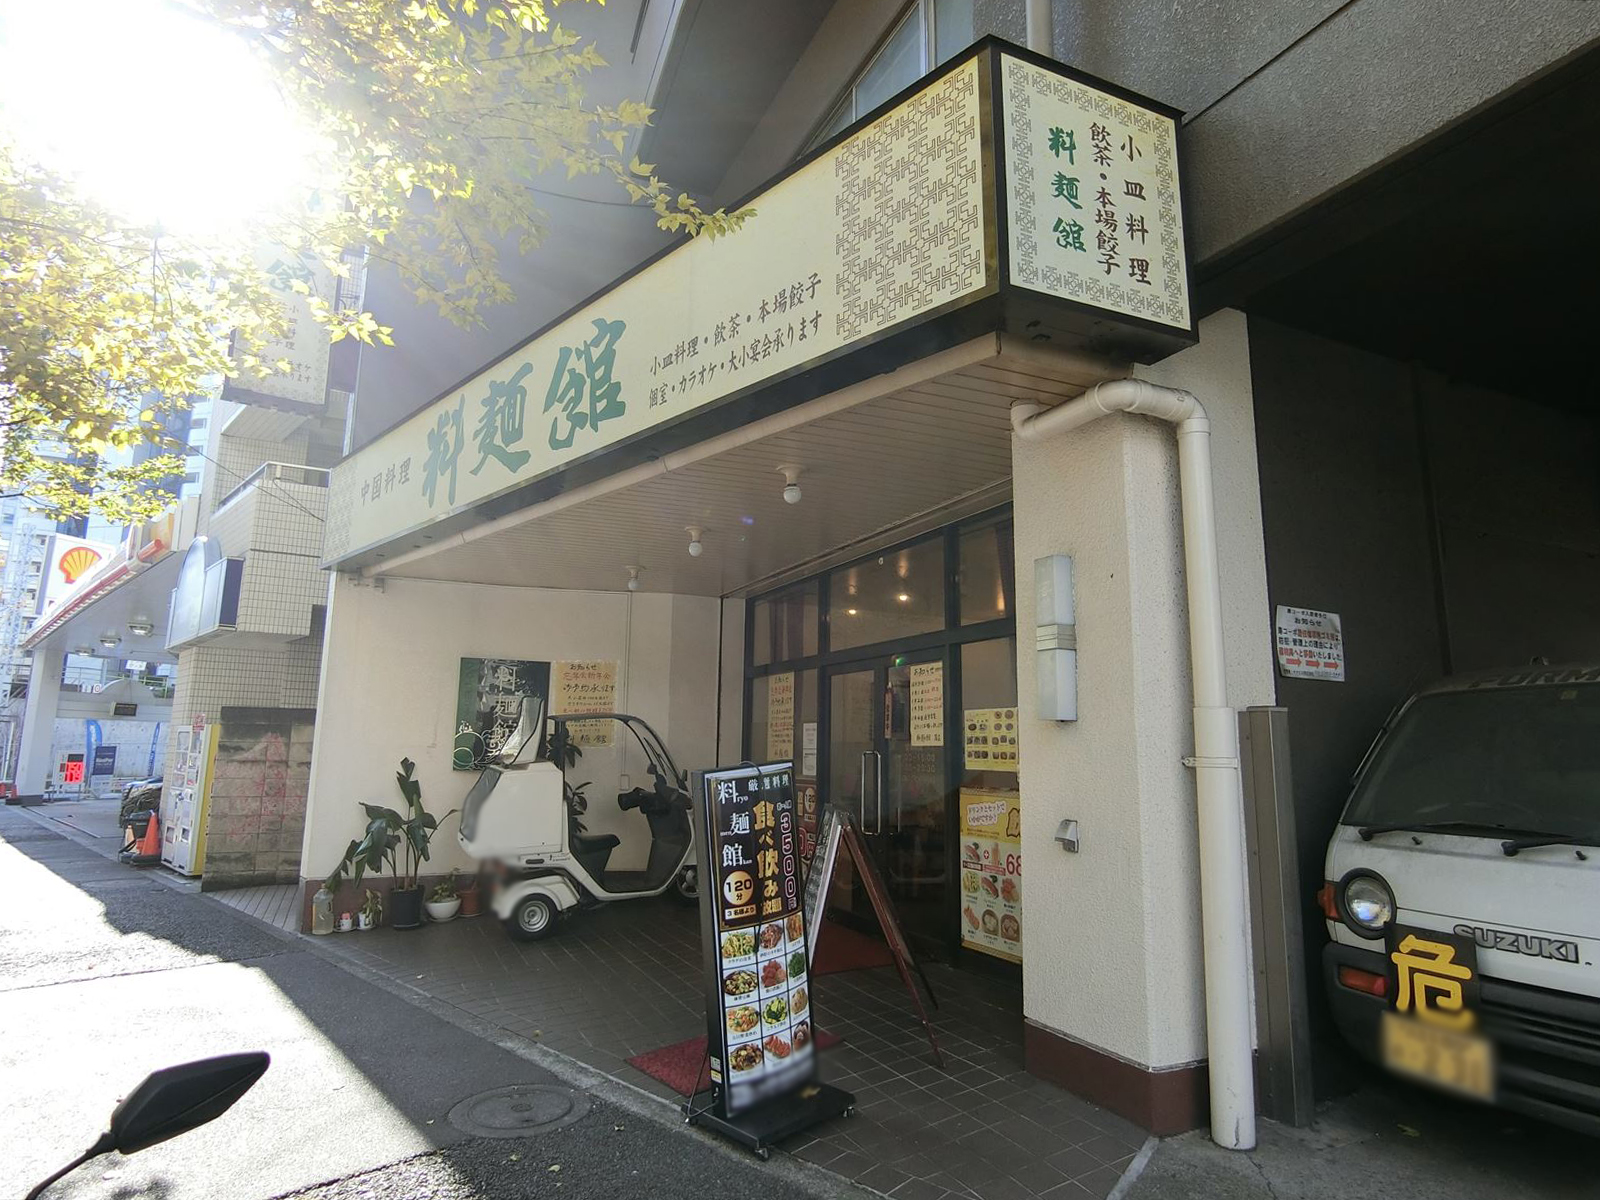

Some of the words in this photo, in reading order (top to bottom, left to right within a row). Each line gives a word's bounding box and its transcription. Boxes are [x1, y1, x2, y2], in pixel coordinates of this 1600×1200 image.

[1089, 122, 1121, 276] 飲茶・本場餃子
[1121, 134, 1152, 286] 小皿料理
[359, 456, 412, 507] 中国料理
[1294, 617, 1323, 627] お知らせ
[726, 878, 753, 894] 120
[1453, 924, 1580, 964] SUZUKI
[1391, 934, 1474, 1031] 危
